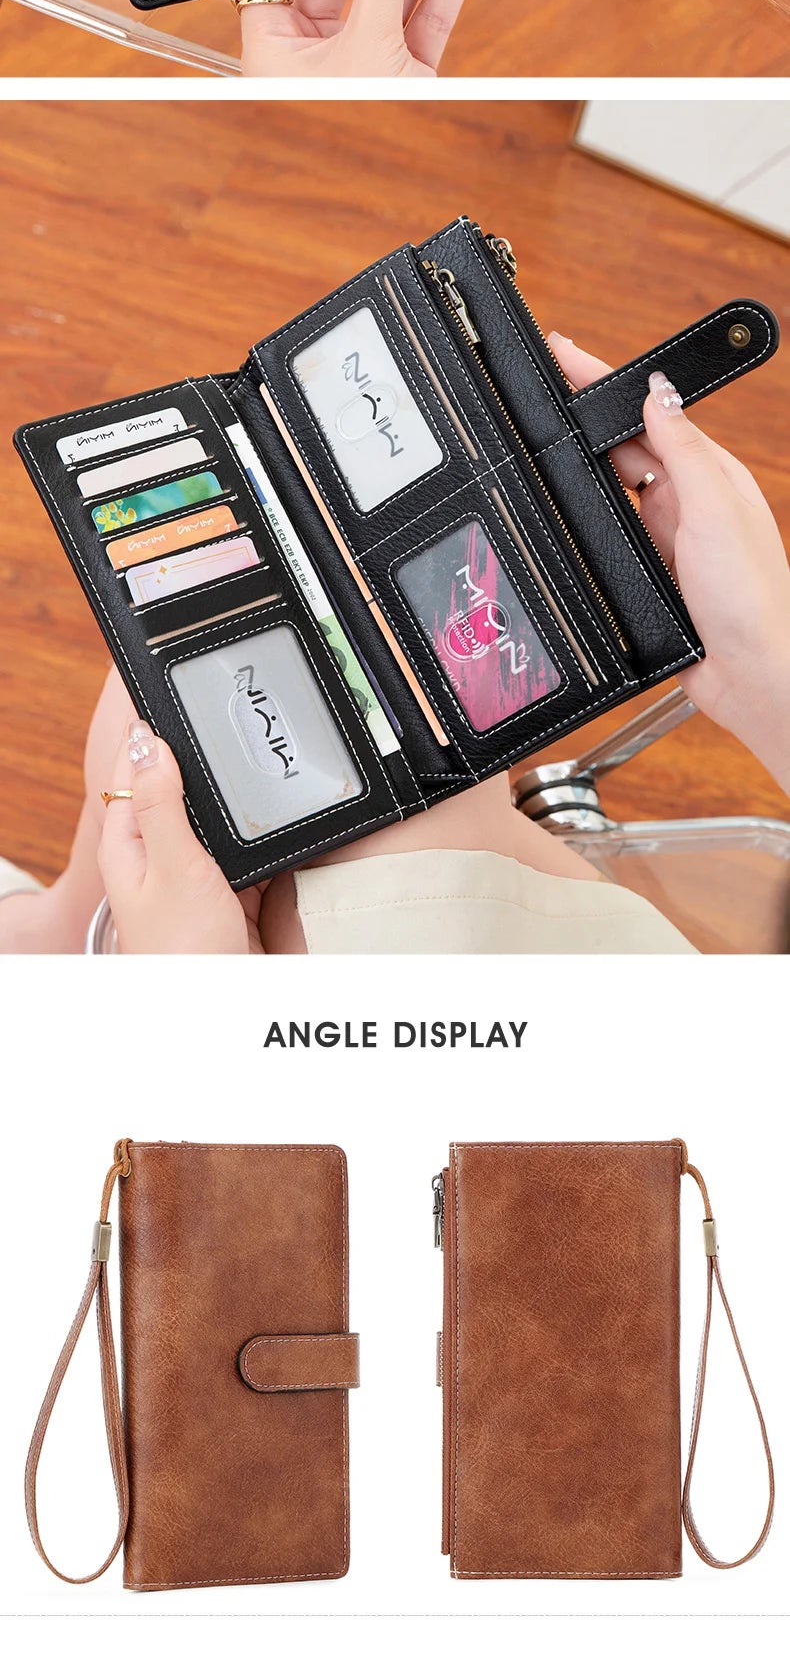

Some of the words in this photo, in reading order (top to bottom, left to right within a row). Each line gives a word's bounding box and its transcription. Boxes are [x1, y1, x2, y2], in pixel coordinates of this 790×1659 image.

[269, 513, 280, 527] BCE
[276, 528, 287, 543] ECB
[284, 543, 295, 557] EZB
[291, 559, 302, 572] EKT
[298, 573, 310, 587] EKP
[447, 617, 470, 653] Protection
[453, 610, 475, 639] RFID
